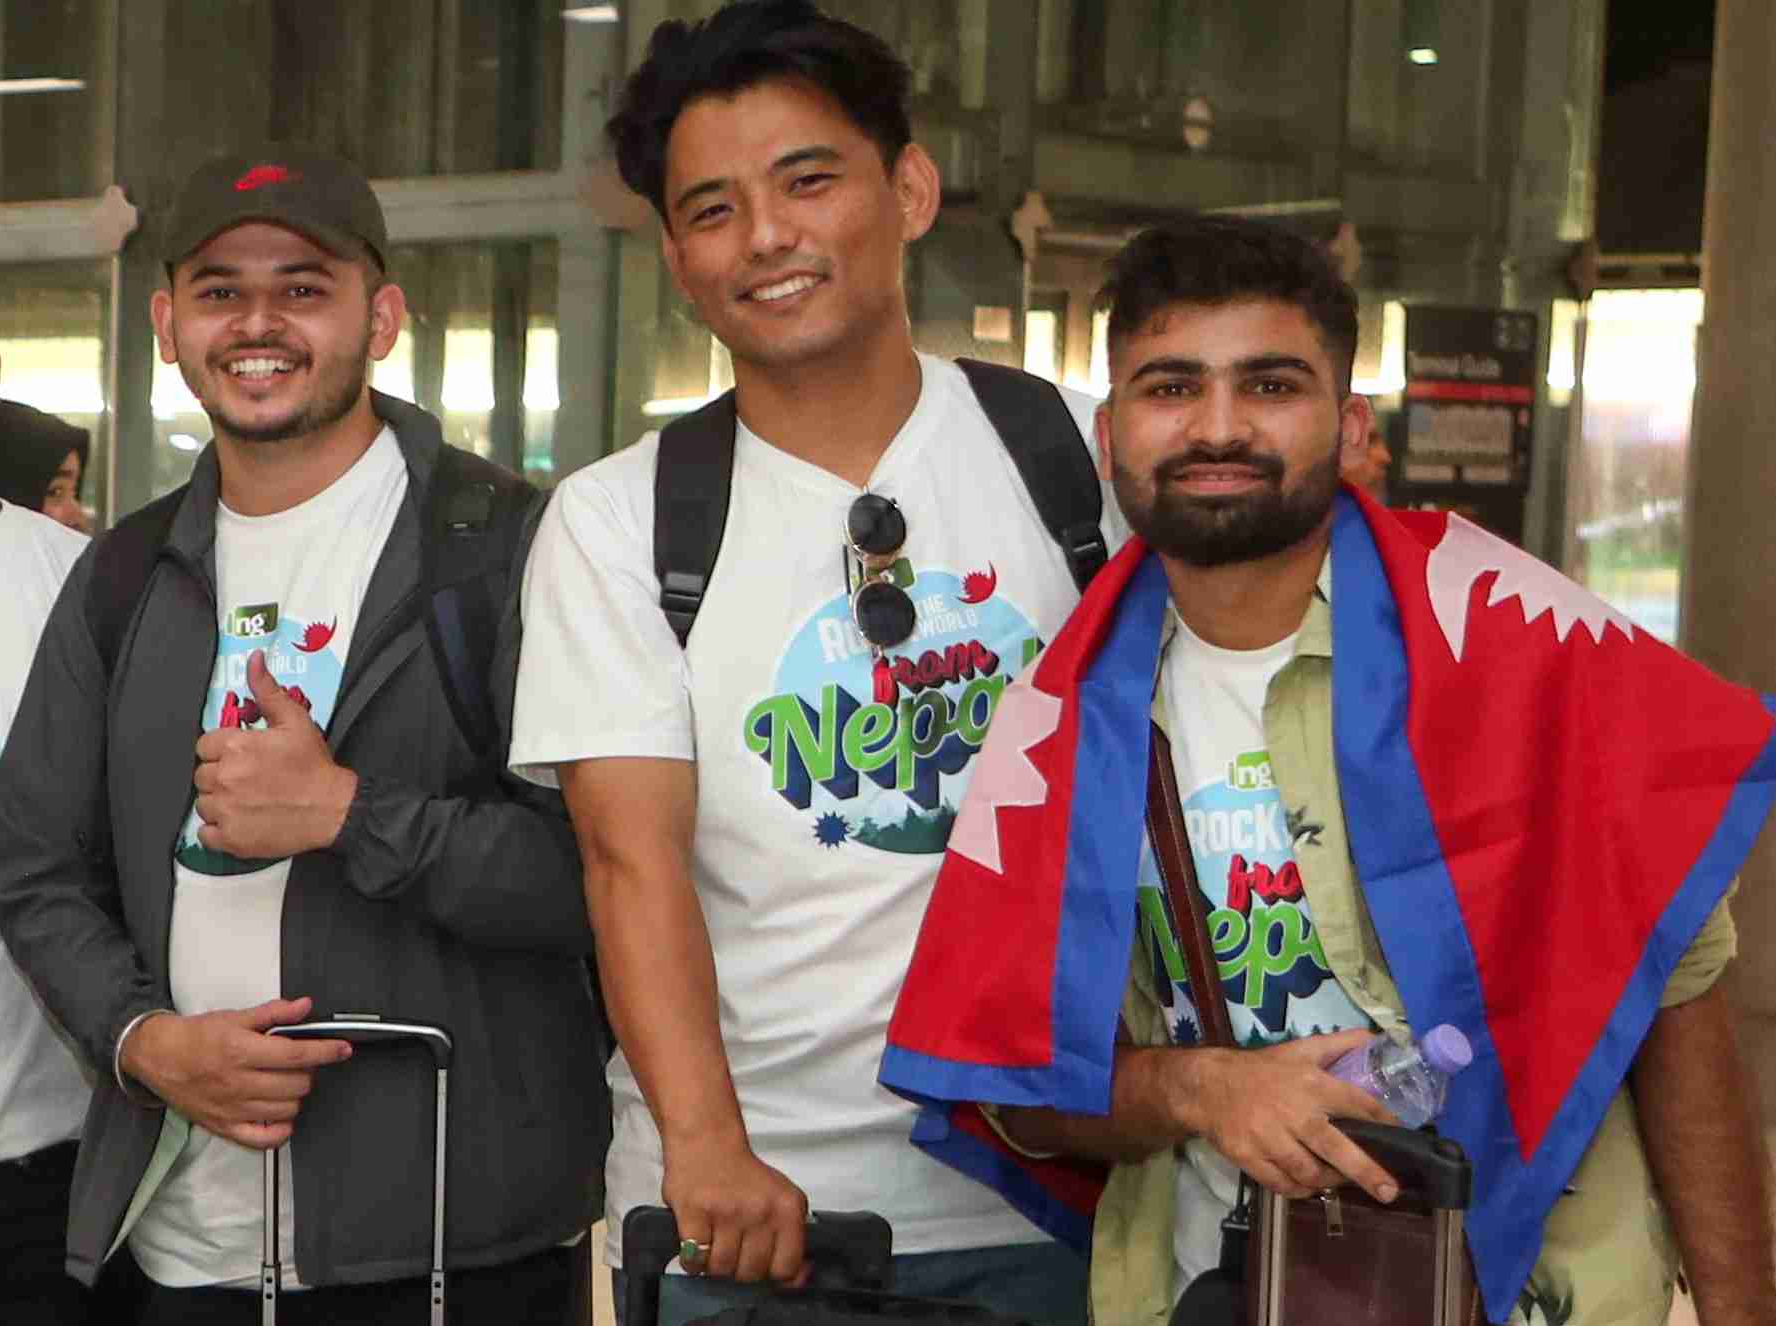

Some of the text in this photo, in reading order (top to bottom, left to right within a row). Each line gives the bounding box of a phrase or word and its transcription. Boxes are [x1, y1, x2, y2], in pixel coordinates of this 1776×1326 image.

[872, 639, 1000, 706] from
[1184, 801, 1283, 858] ROCK
[1227, 853, 1305, 912] fro
